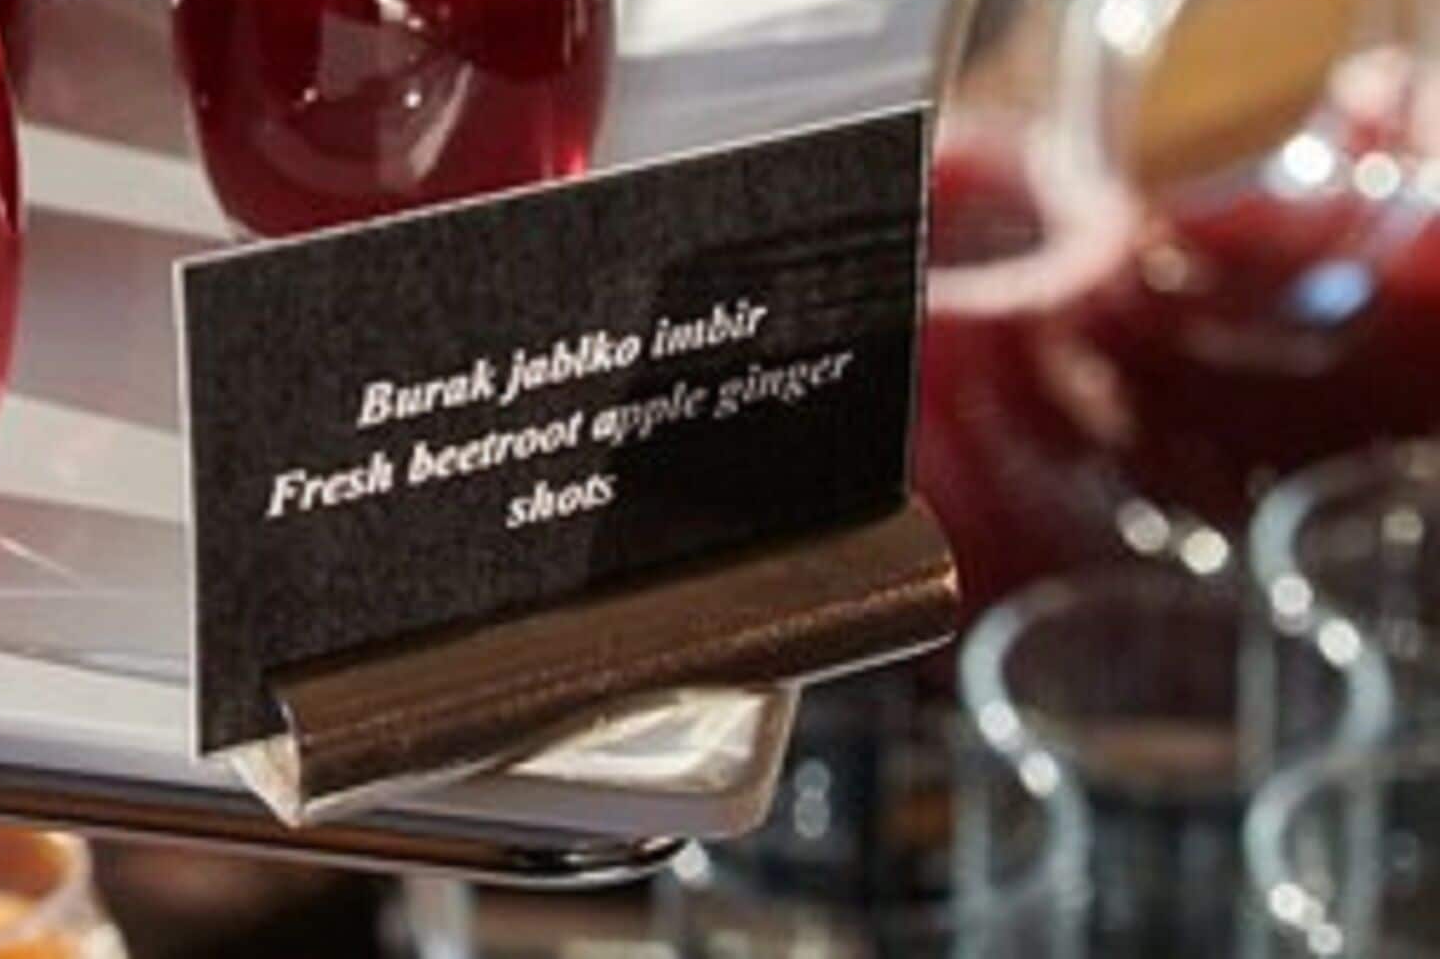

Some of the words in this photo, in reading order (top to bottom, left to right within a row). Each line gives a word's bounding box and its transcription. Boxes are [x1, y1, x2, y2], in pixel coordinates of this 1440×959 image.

[359, 360, 496, 427] Burak
[651, 302, 767, 359] imbir
[265, 454, 393, 518] Fresh
[408, 409, 581, 485] beetroot
[592, 386, 706, 447] apple
[714, 349, 854, 418] ginger
[506, 471, 617, 528] shots
